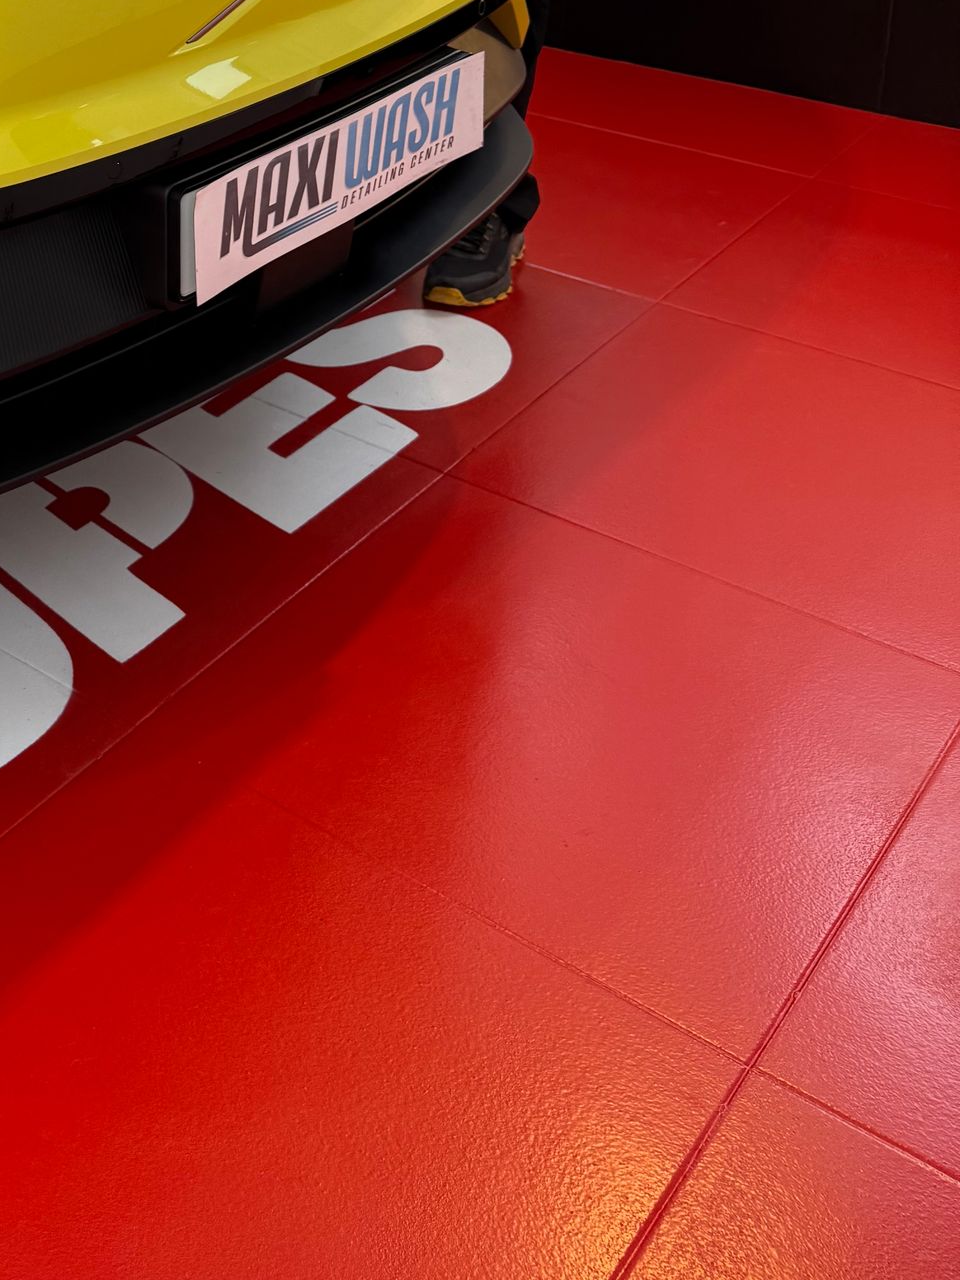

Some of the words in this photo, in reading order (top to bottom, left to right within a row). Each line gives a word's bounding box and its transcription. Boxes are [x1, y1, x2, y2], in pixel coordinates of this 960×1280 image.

[220, 128, 340, 258] MAXI
[343, 67, 461, 190] WASH
[340, 164, 404, 210] DETAILING
[409, 135, 455, 169] CENTER
